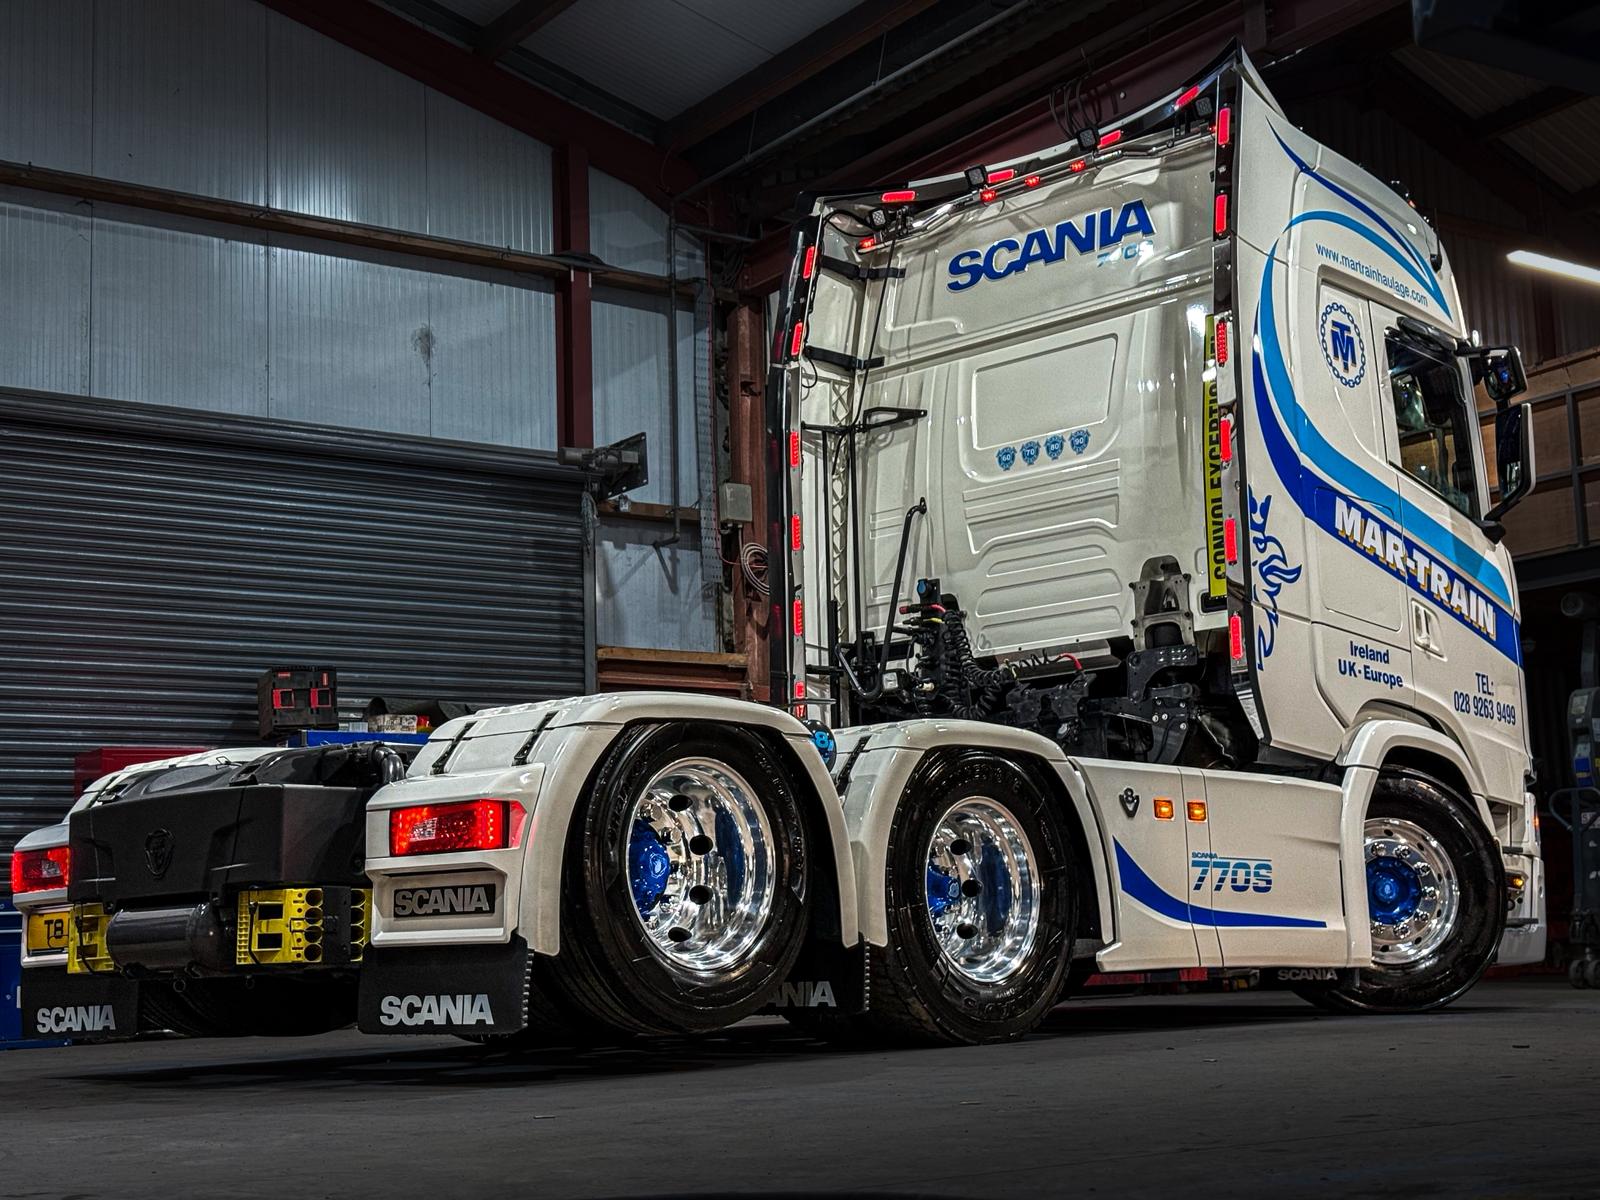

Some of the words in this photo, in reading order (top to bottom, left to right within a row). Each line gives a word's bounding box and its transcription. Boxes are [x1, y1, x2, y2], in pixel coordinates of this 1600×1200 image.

[947, 199, 1156, 293] SCANIA
[1315, 243, 1428, 307] www.martrainhaulage.com
[1002, 454, 1011, 463] 60
[1026, 449, 1035, 457] 70
[1050, 443, 1060, 452] 80
[1334, 496, 1497, 641] MAR-TRAIN
[1350, 640, 1390, 664] Ireland
[1475, 672, 1494, 696] TEL:
[1453, 690, 1471, 714] 028
[1472, 695, 1494, 720] 9263
[1496, 701, 1516, 726] 9499
[1191, 851, 1218, 859] SCANIA
[1191, 859, 1273, 893] 770S
[394, 886, 490, 916] SCANIA
[1277, 968, 1338, 981] SCANIA
[36, 1004, 116, 1033] SCANIA
[379, 994, 495, 1026] SCANIA
